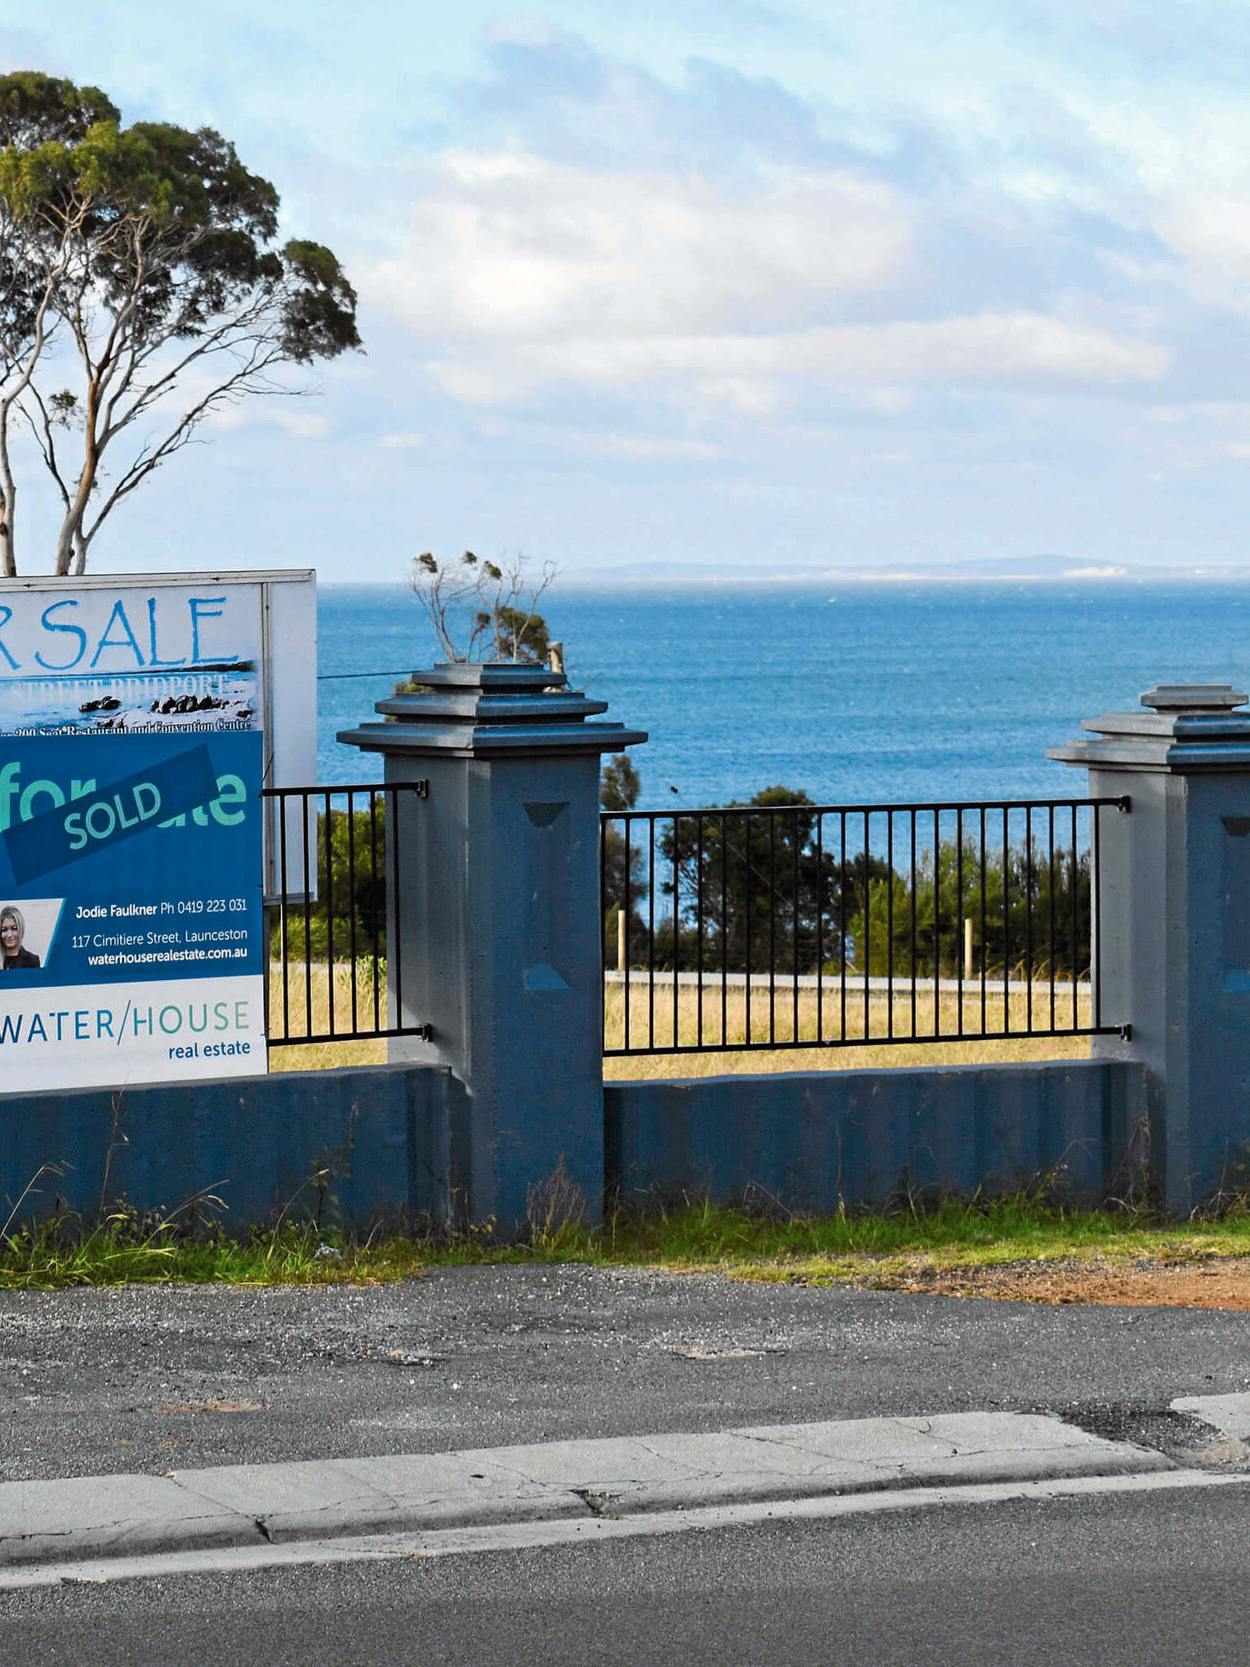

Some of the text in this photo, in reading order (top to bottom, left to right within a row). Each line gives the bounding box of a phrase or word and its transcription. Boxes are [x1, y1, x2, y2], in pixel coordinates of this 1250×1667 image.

[35, 597, 238, 671] SALE
[110, 673, 228, 701] BRIDPORT
[64, 782, 161, 850] SOLD
[76, 898, 247, 919] Jodie Faulkner Ph 0419 223 031
[72, 928, 247, 948] 117 Cimitiere Street, Launceston
[88, 948, 247, 966] waterhouserealestate.com.au
[169, 1040, 251, 1059] real estate
